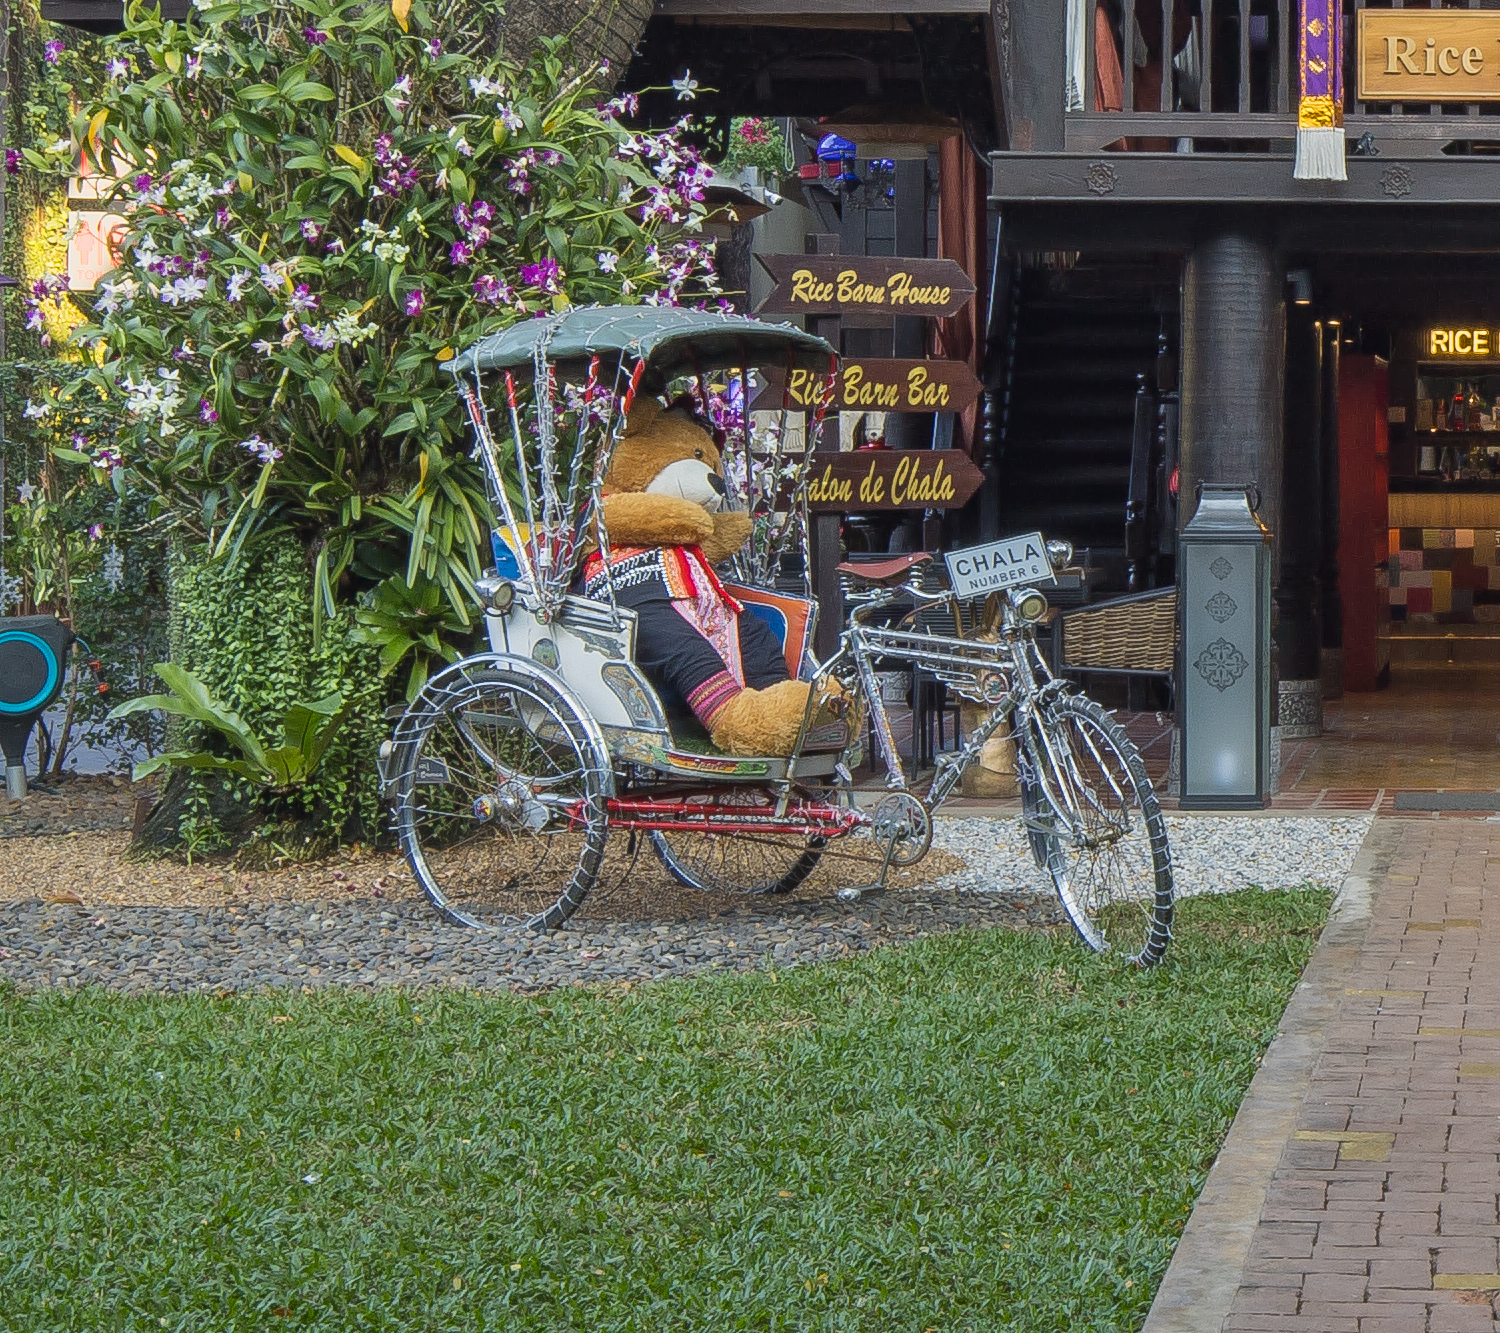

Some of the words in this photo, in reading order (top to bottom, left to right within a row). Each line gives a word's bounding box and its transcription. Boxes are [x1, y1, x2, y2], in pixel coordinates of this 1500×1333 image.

[1383, 35, 1484, 76] Rice
[790, 269, 834, 303] Rice
[836, 270, 885, 304] Barn
[887, 272, 951, 306] House
[1430, 329, 1490, 355] RICE
[842, 364, 900, 407] Barn
[906, 366, 950, 407] Bar
[794, 463, 852, 502] alon
[859, 459, 886, 504] de
[891, 455, 956, 506] Chala
[955, 543, 1041, 576] CHALA
[968, 567, 1028, 590] NUMBER
[1031, 564, 1040, 575] 6
